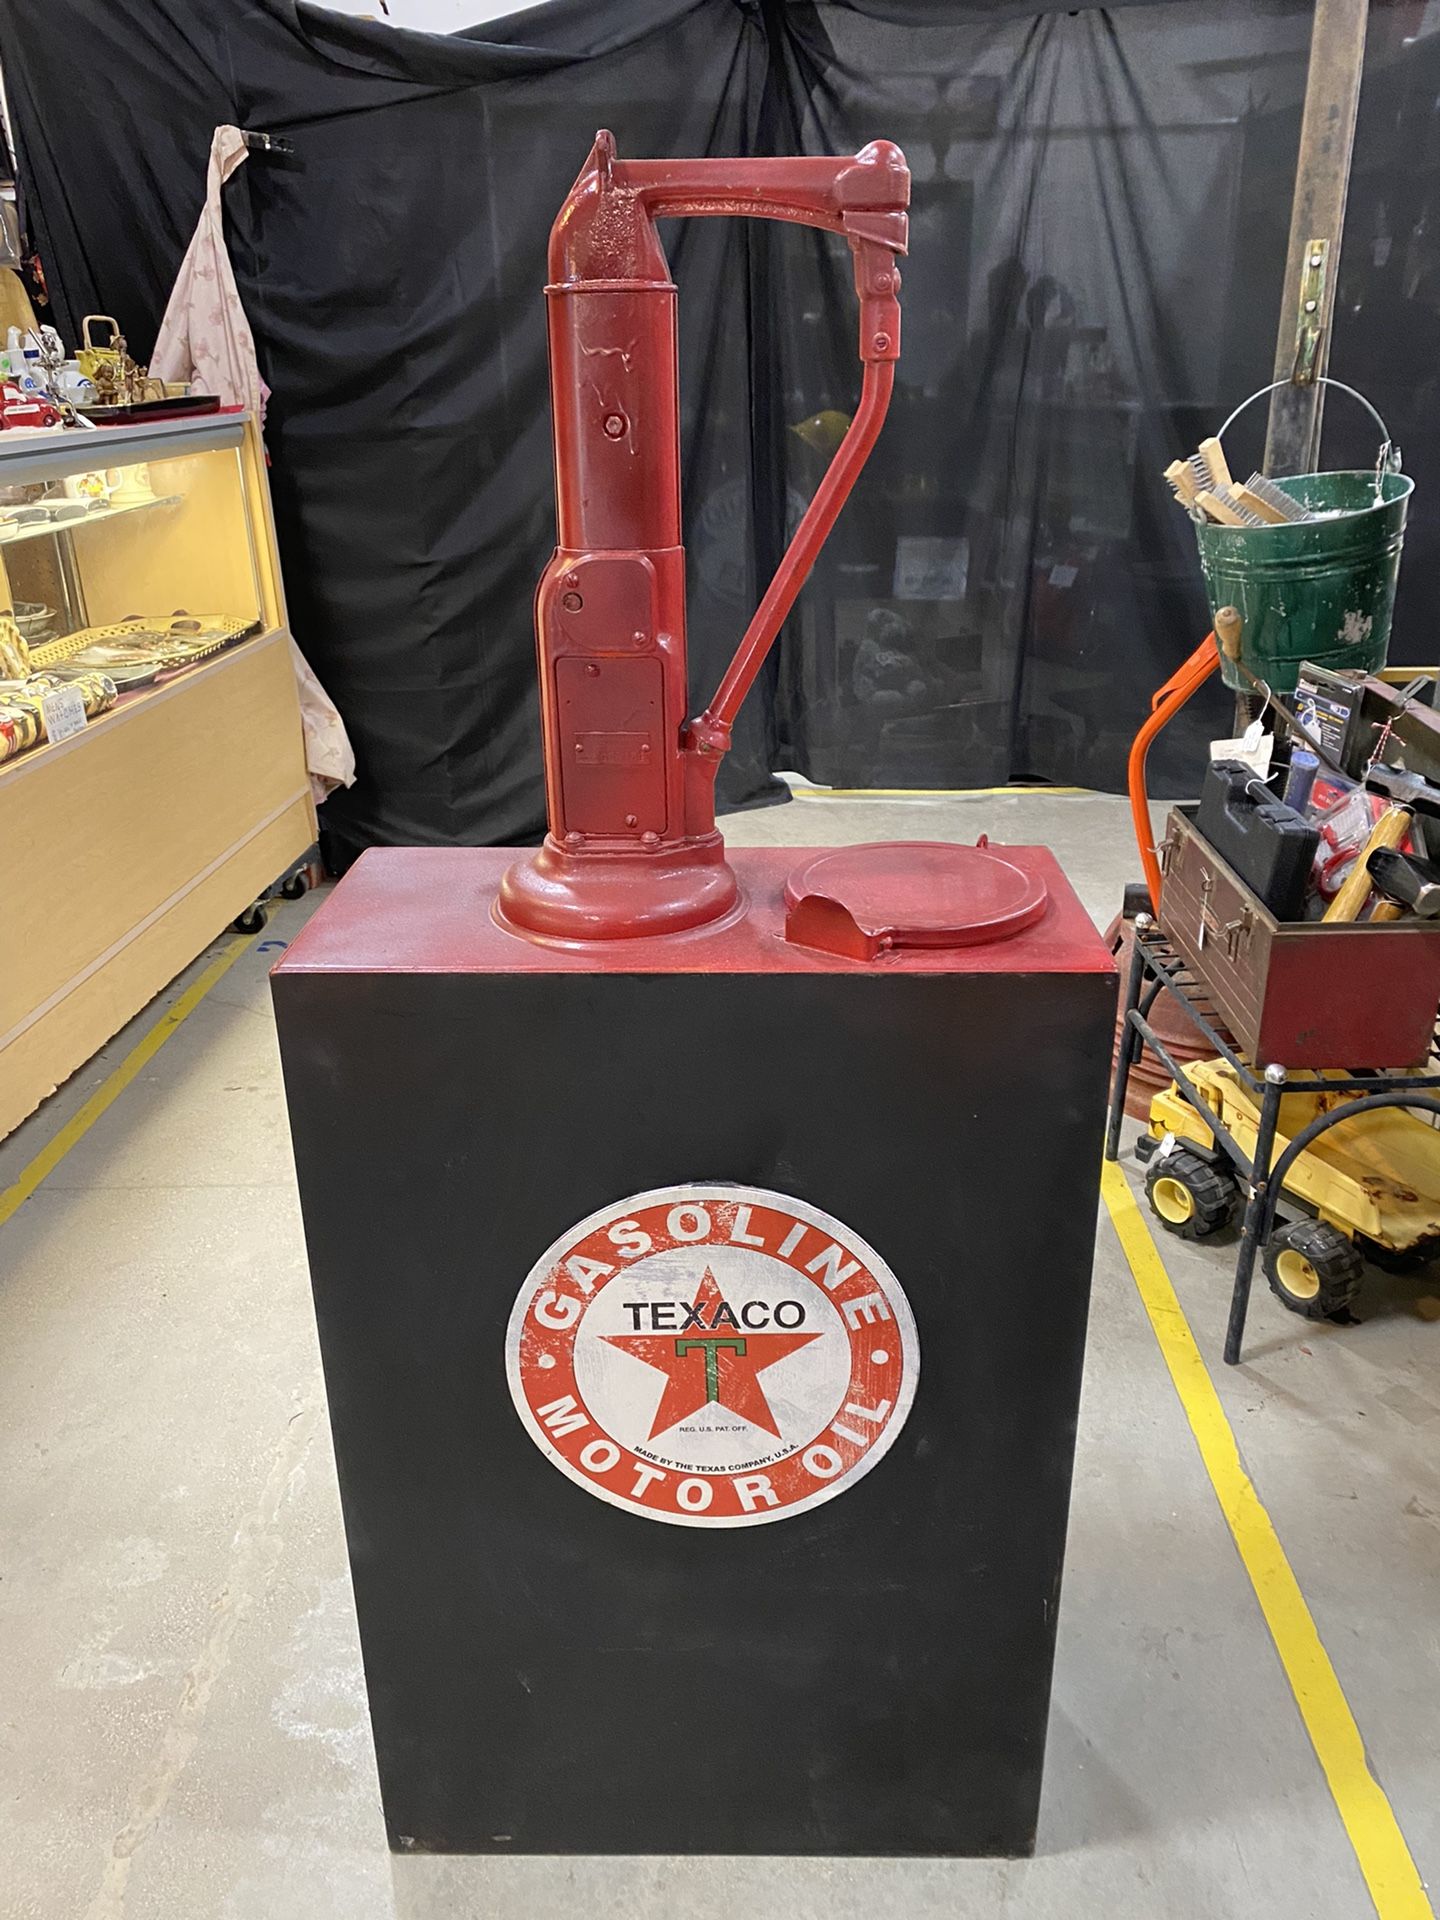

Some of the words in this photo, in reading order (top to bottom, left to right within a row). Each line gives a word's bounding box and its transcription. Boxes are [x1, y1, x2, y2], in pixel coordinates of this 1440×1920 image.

[534, 1204, 891, 1332] GASOLINE
[623, 1300, 807, 1331] TEXACO
[675, 1338, 748, 1403] T
[537, 1395, 782, 1512] MOTOR
[802, 1399, 892, 1479] OIL
[633, 1445, 659, 1461] MADE
[660, 1458, 674, 1467] BY
[675, 1462, 694, 1471] THE
[728, 1456, 775, 1471] COMPANY,
[774, 1444, 799, 1459] U.S.A.
